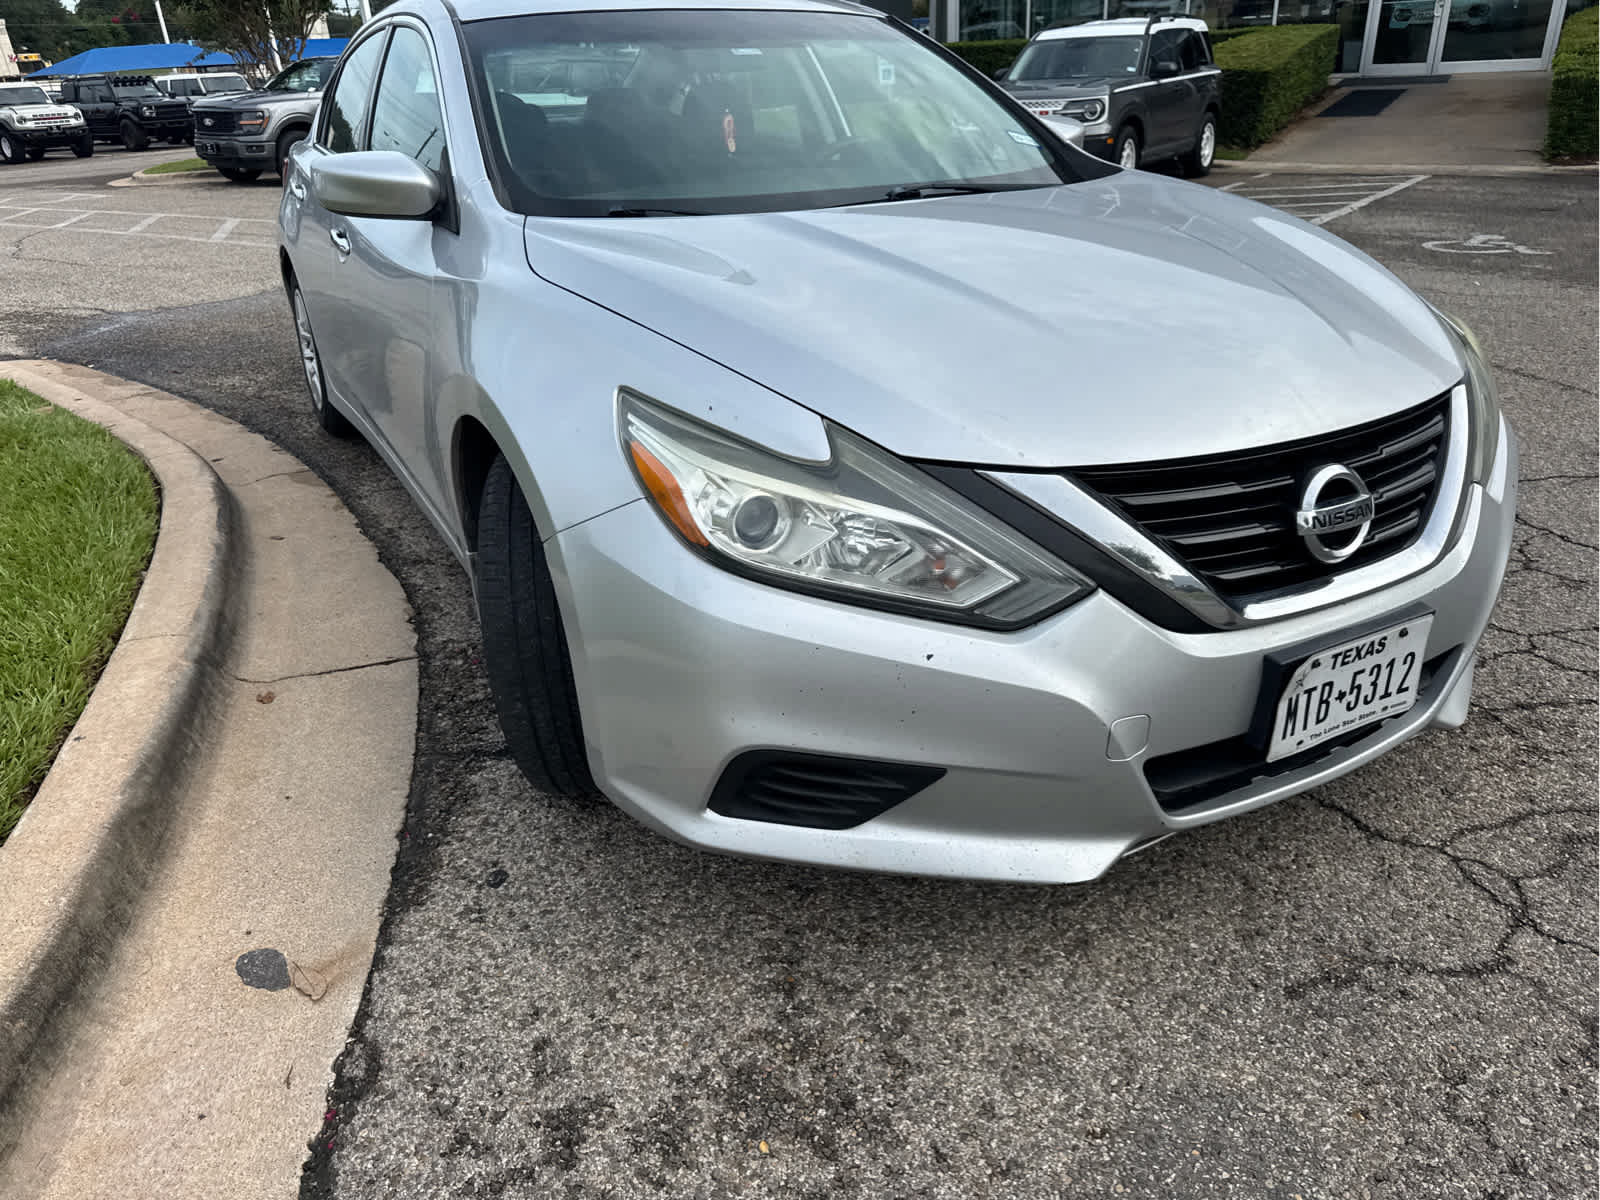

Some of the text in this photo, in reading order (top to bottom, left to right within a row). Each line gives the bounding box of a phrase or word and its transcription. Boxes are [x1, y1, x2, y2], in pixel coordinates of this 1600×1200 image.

[1312, 504, 1372, 529] NISSAN
[1331, 636, 1388, 670] TEXAS
[1310, 730, 1322, 740] The
[1323, 723, 1340, 734] Lone
[1342, 716, 1357, 727] Star
